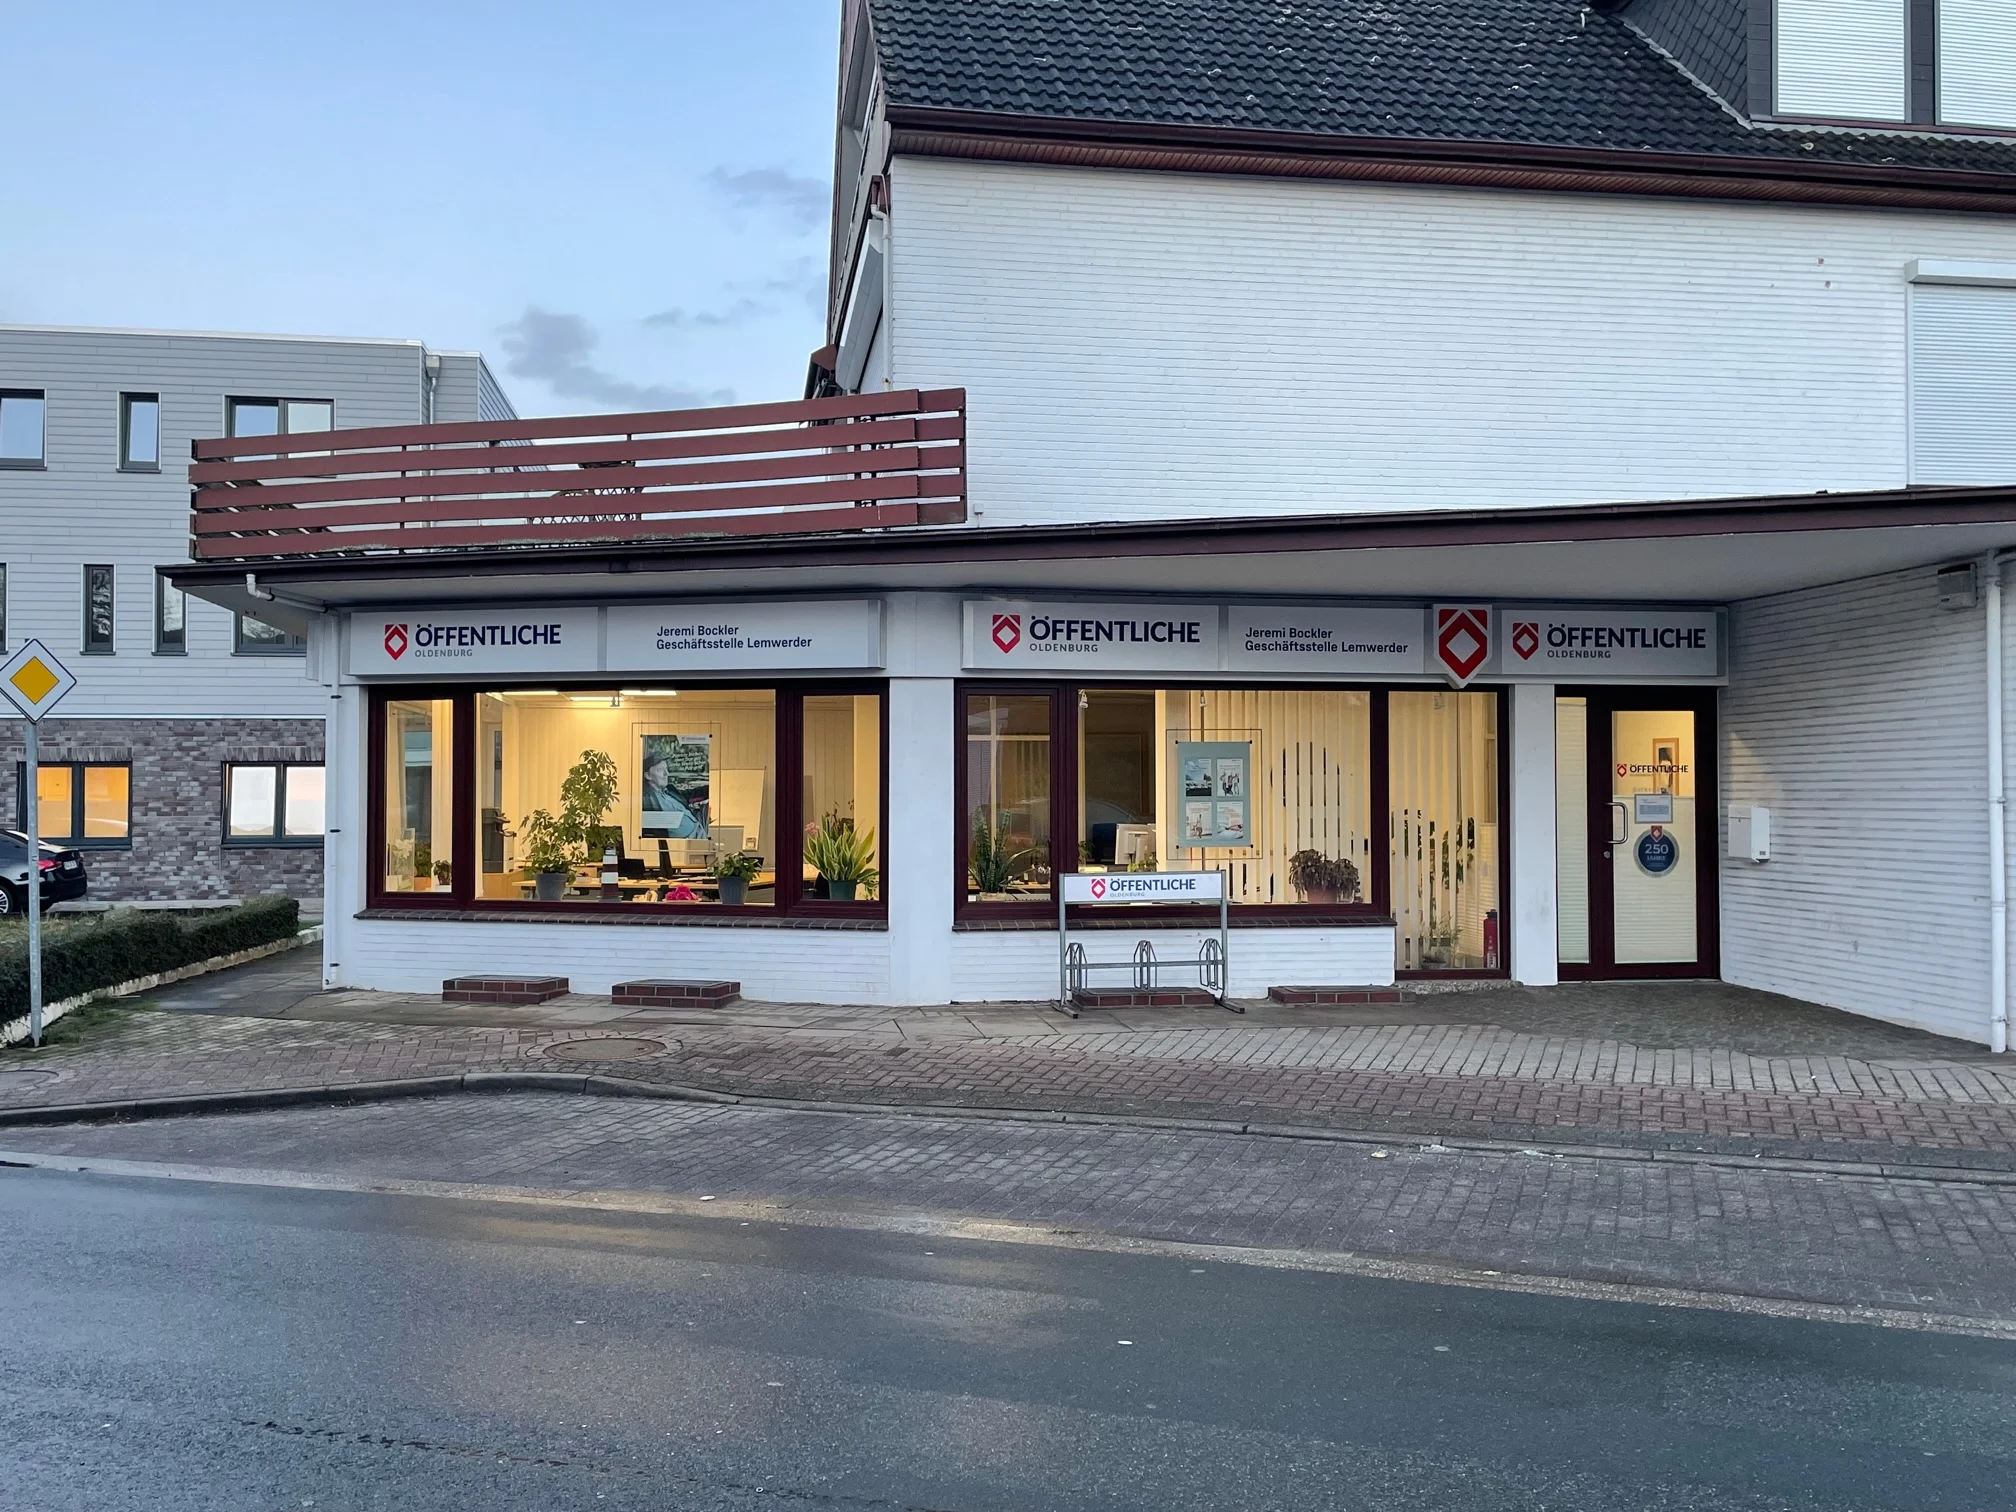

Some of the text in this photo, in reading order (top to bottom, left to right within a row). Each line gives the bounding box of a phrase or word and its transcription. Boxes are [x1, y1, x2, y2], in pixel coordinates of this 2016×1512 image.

[415, 623, 562, 647] ÖFFENTLICHE
[656, 625, 739, 637] Jeremi Bockler
[1029, 615, 1200, 643] ÖFFENTLICHE
[1245, 627, 1333, 639] Jeremi Bockler
[1547, 623, 1706, 648] ÖFFENTLICHE
[656, 636, 813, 650] Geschäftsstelle Lemwerder
[1029, 643, 1098, 653] OLDENBURG
[1245, 640, 1409, 653] Geschäftsstelle Lemwerder
[414, 648, 473, 658] OLDENBURG
[1547, 650, 1611, 659] OLDENBURG
[1629, 763, 1689, 773] ÖFFENTLICHE
[1644, 843, 1669, 855] 250
[1110, 878, 1196, 892] ÖFFENTLICHE
